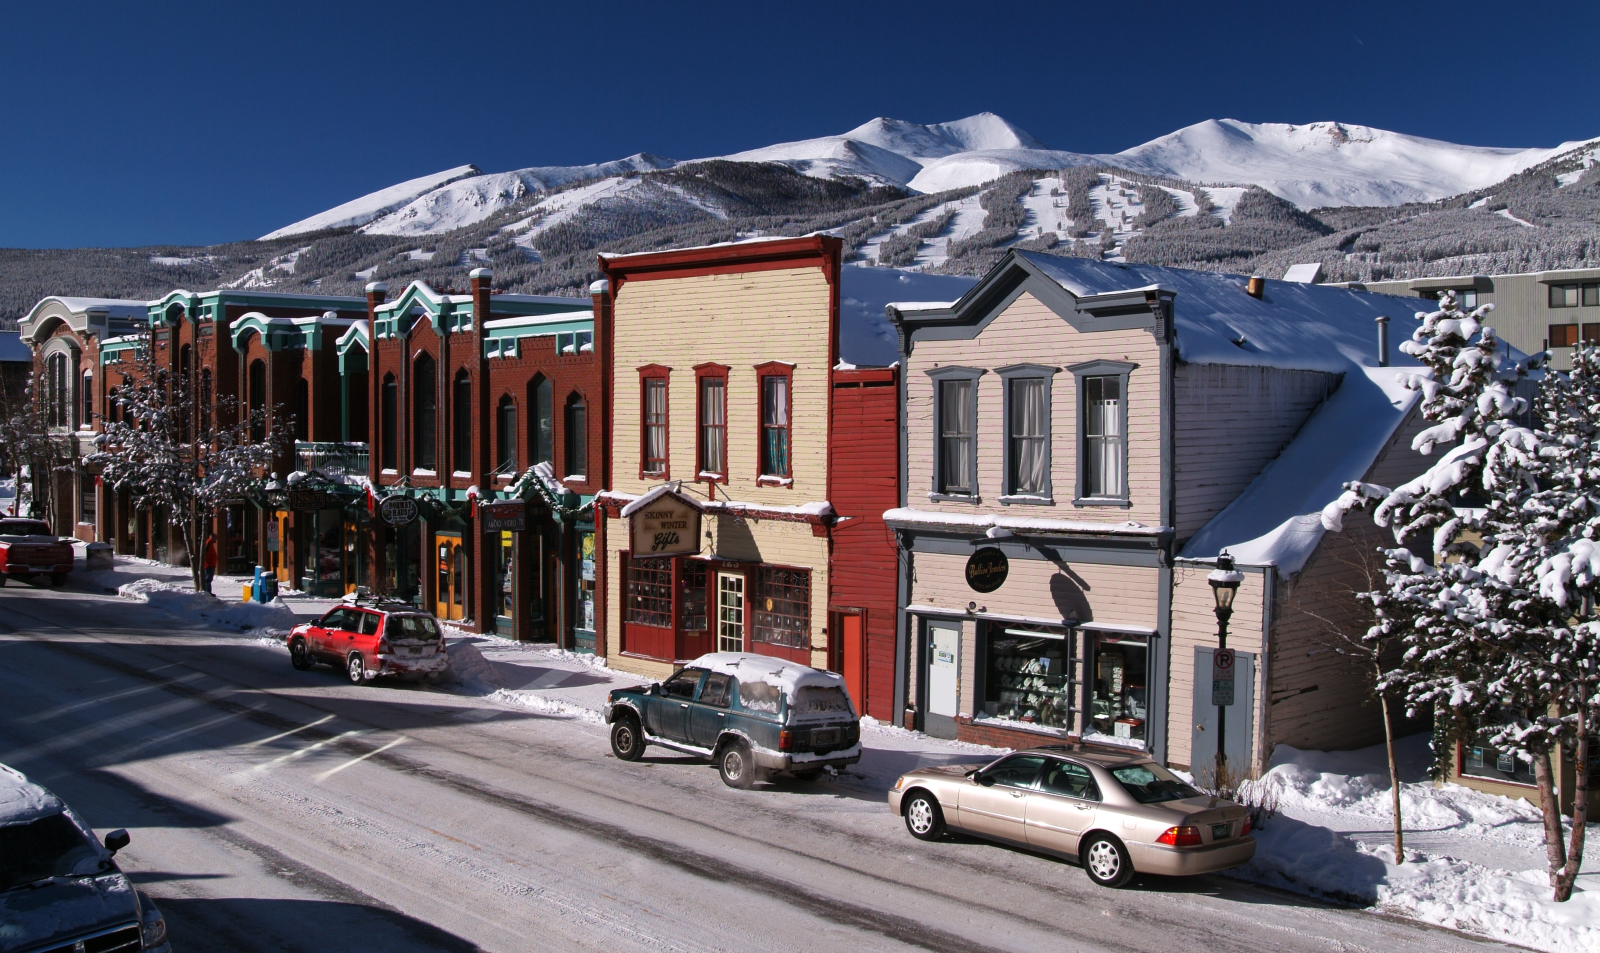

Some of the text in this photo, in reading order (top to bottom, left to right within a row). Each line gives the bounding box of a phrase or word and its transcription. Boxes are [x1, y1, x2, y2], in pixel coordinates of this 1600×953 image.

[304, 493, 324, 503] SOUTH
[388, 501, 412, 510] NORWAY
[487, 504, 525, 513] ALPINE
[392, 509, 408, 517] HAUS
[645, 511, 674, 520] SKINNY
[660, 520, 687, 530] WINTER
[652, 532, 680, 551] Gifts
